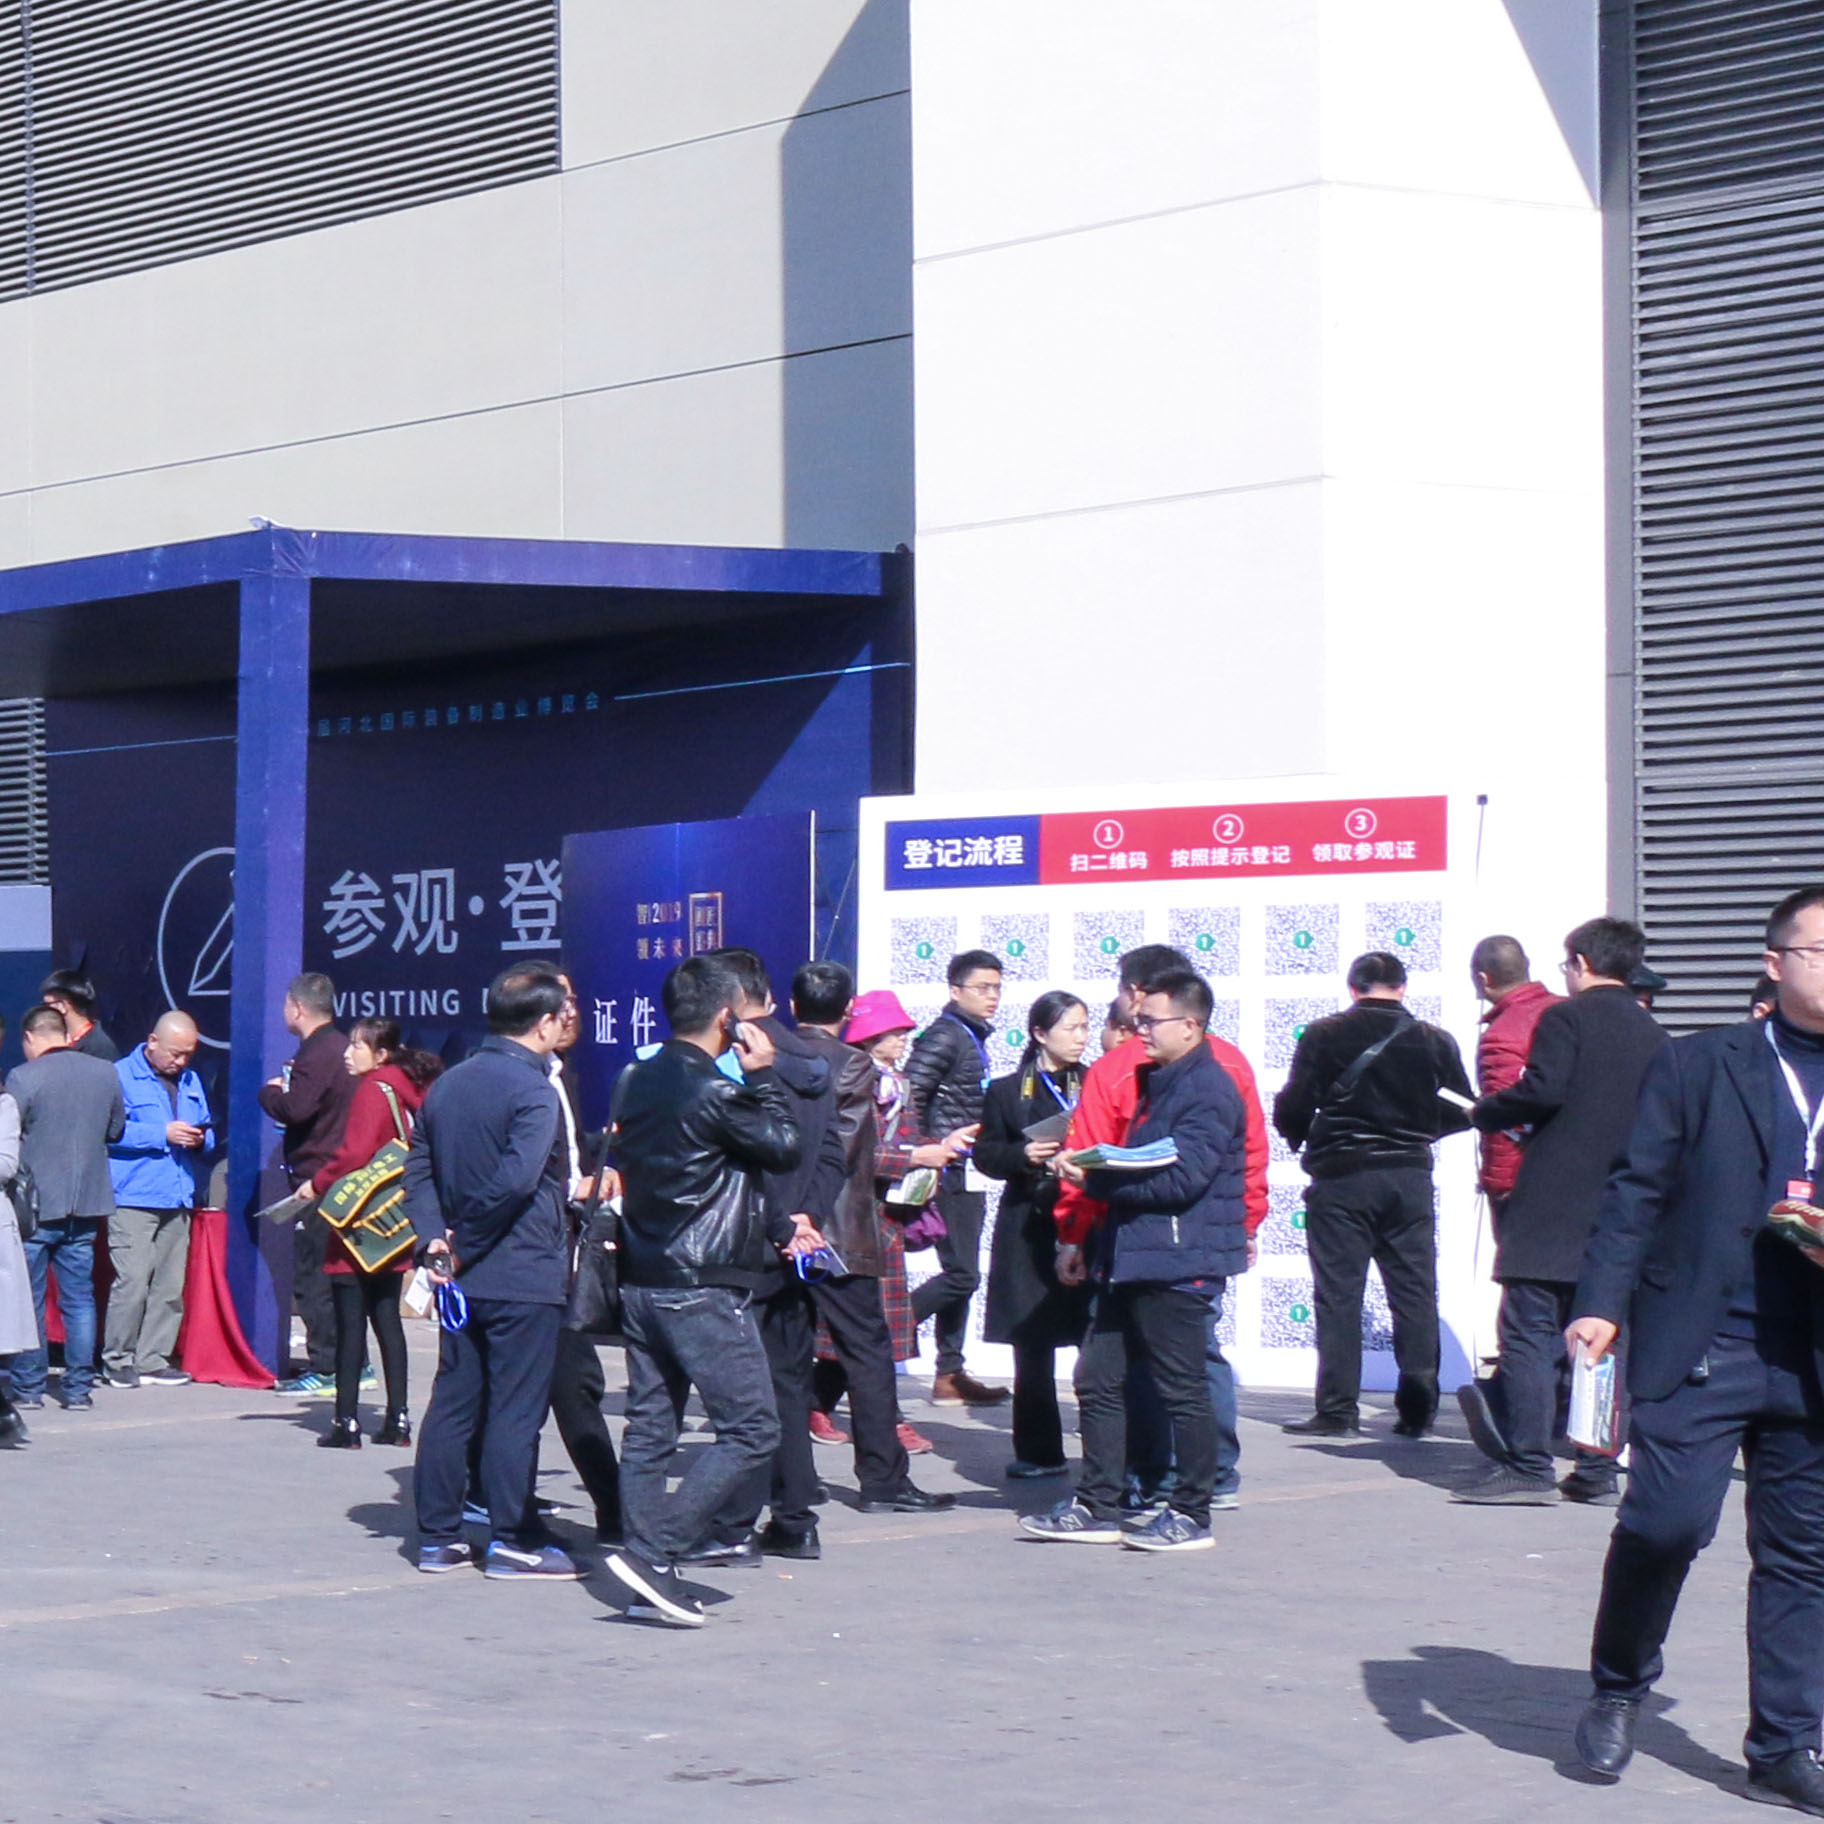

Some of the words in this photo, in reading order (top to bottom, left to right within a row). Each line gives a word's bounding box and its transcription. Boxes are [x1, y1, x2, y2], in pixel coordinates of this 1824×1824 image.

[903, 834, 1025, 869] 登记流程
[1070, 851, 1148, 873] 扫二维码
[1170, 845, 1291, 868] 按照提示登记
[1312, 840, 1416, 863] 领取参观证
[332, 988, 461, 1018] VISITING
[593, 996, 657, 1046] 证件
